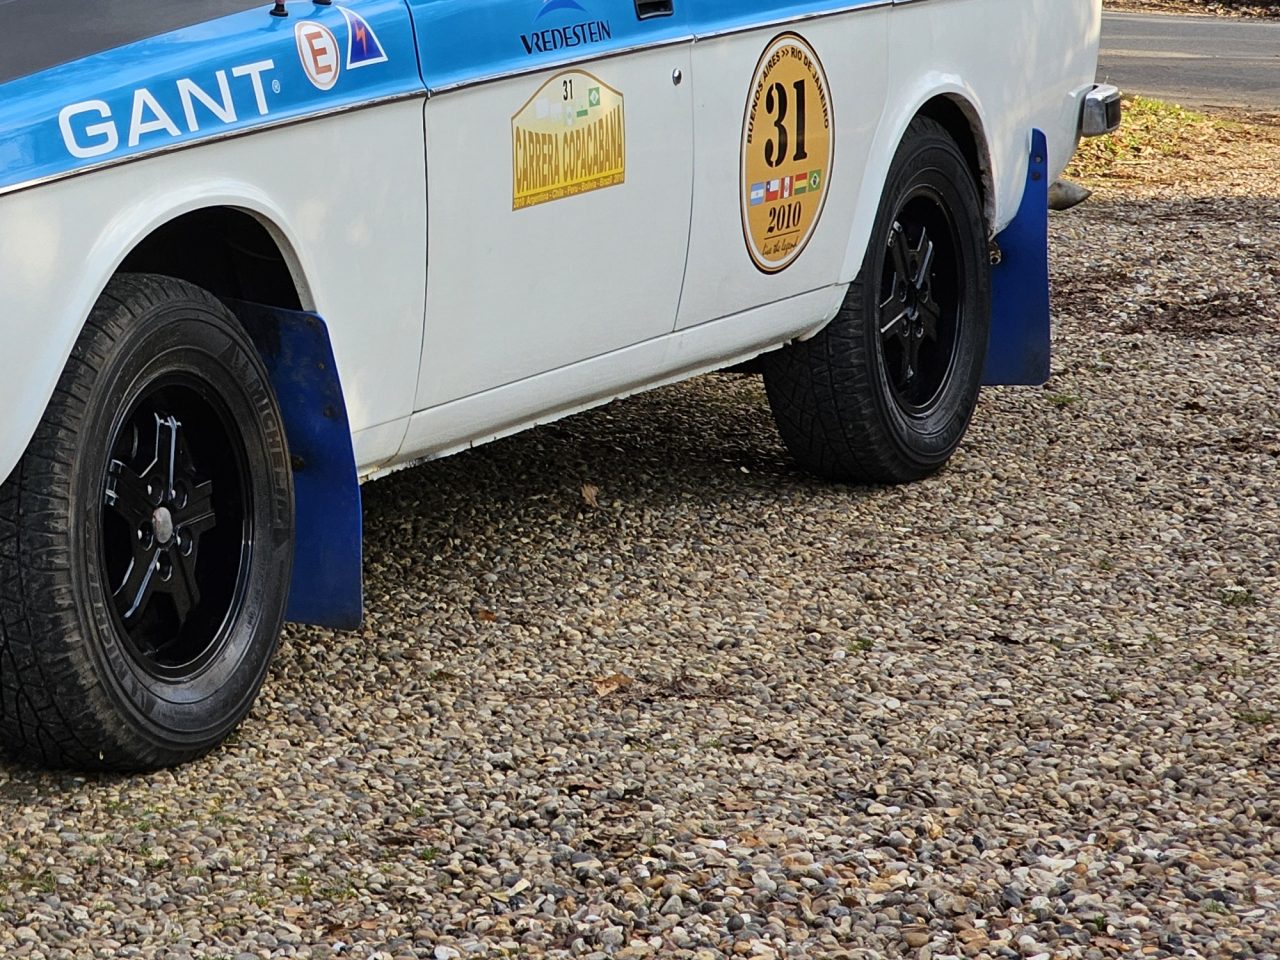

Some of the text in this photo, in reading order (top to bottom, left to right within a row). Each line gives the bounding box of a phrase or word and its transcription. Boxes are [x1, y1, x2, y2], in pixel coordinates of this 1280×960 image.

[304, 31, 333, 77] E
[520, 19, 611, 55] VREDESTEIN
[562, 79, 574, 101] 31
[747, 47, 830, 144] BUENOS AIRES RIO DE JANEIRO
[764, 79, 808, 168] 31
[515, 104, 623, 194] CARRERA COPACABANA
[767, 201, 801, 233] 2010
